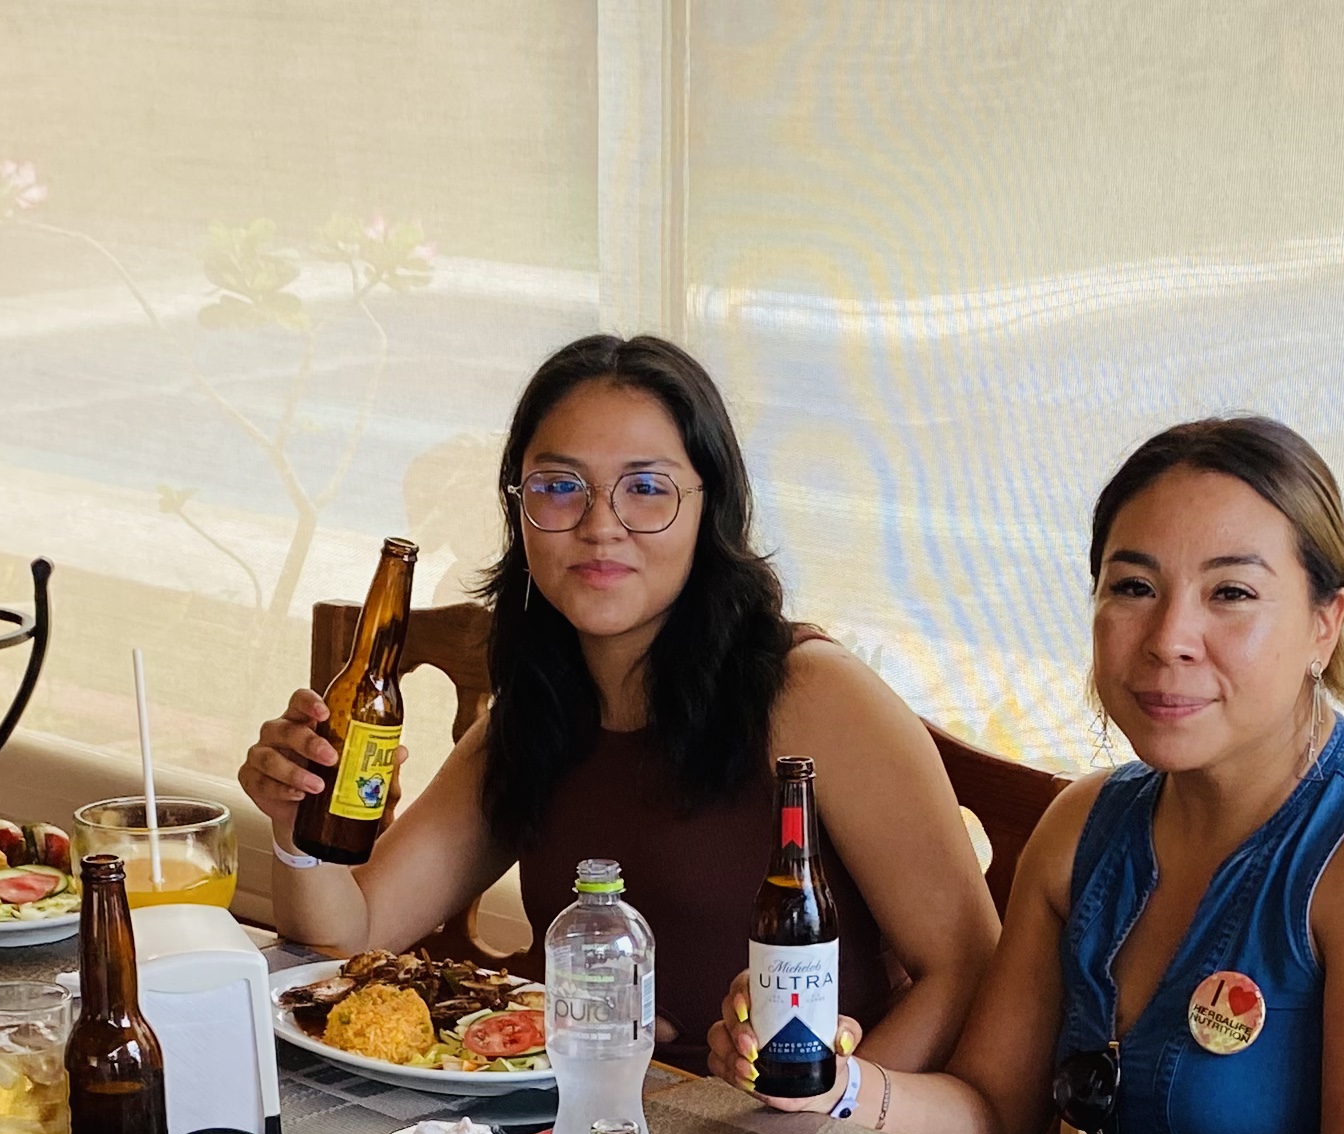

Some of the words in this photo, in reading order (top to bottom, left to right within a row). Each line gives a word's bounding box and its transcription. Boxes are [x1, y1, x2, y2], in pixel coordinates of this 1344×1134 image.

[759, 972, 833, 990] ULTRA
[1211, 980, 1225, 1006] I
[1190, 1012, 1251, 1044] NUTRITION
[1193, 1004, 1253, 1035] HERBALIFE
